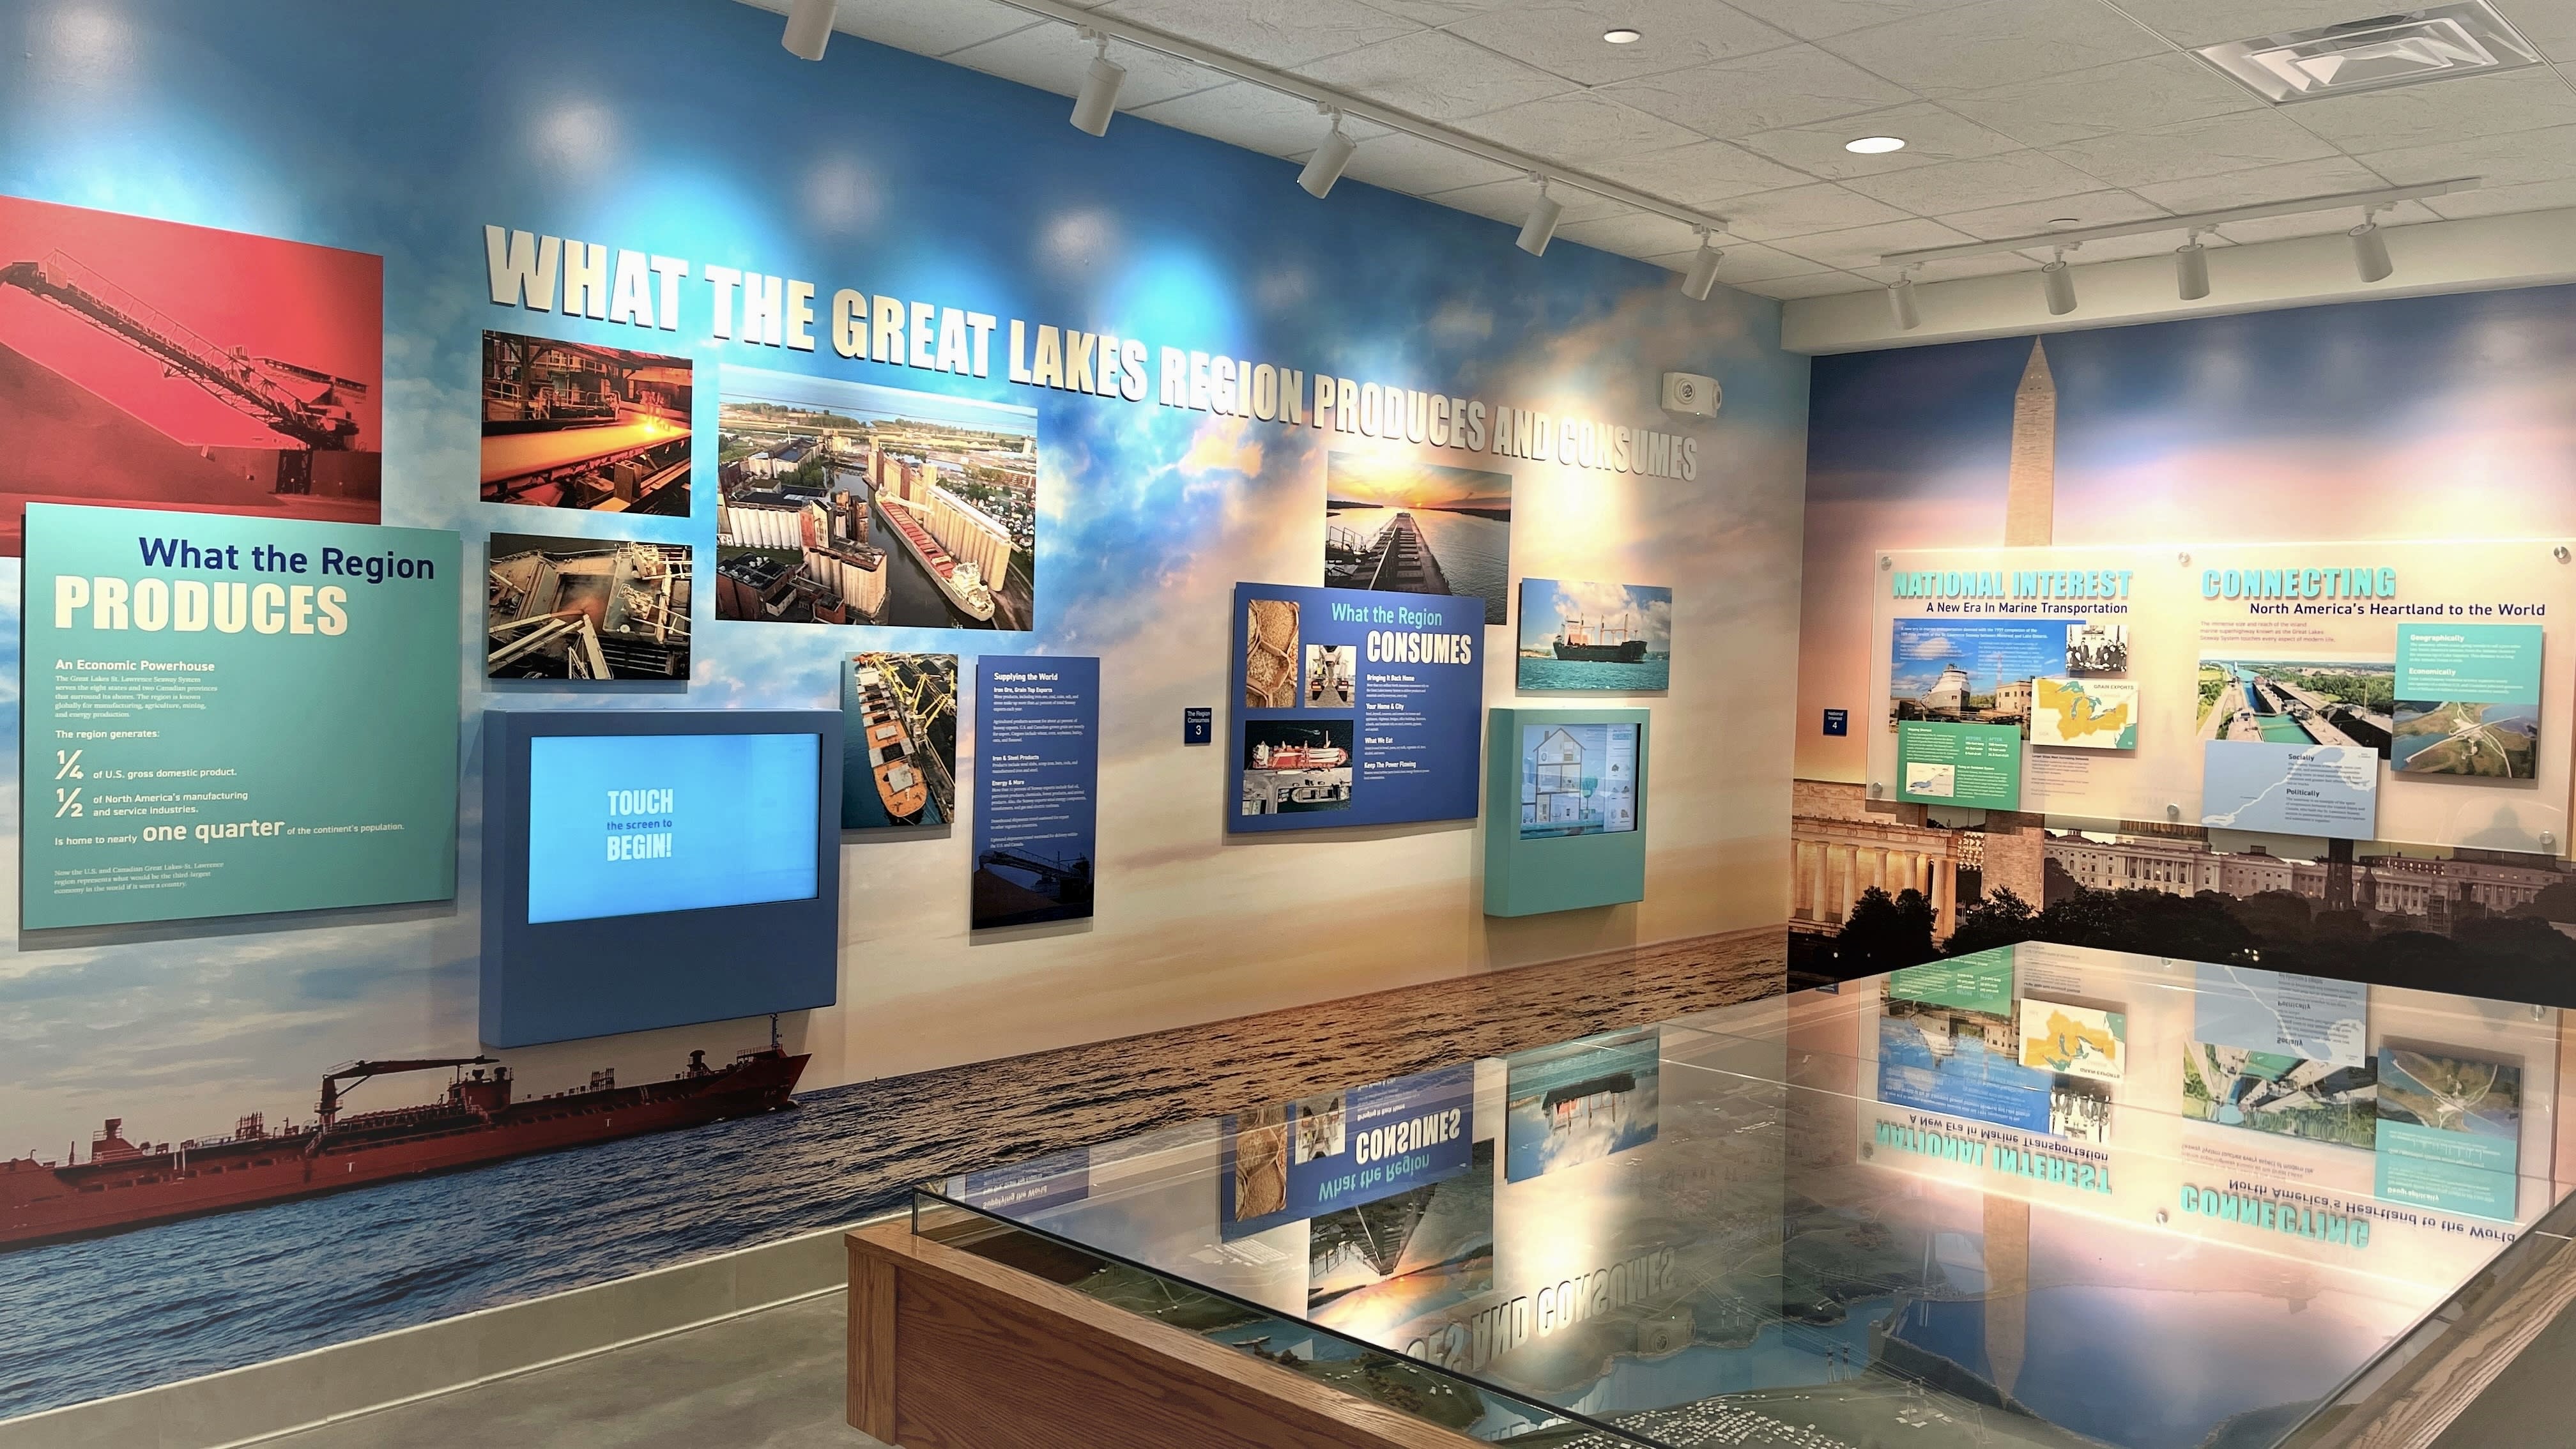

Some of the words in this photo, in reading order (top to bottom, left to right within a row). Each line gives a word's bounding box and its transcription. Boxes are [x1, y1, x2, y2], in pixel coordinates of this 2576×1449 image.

[485, 224, 688, 331] WHAT
[705, 264, 815, 352] THE
[832, 288, 997, 378] GREAT
[1009, 319, 1147, 402] LAKES
[1160, 346, 1302, 425] REGION
[1313, 374, 1486, 452] PRODUCES
[1491, 405, 1551, 462] AND
[1558, 417, 1697, 482] CONSUMES
[139, 537, 238, 571] What
[252, 544, 307, 573] the
[322, 548, 433, 584] Region
[1892, 571, 2005, 599] NATIONAL
[2012, 569, 2133, 600] INTEREST
[2201, 567, 2396, 599] CONNECTING
[55, 575, 348, 637] PRODUCES
[1926, 602, 1933, 611] A
[1937, 602, 1959, 611] New
[1963, 602, 1981, 612] Era
[1985, 602, 1995, 612] In
[1998, 602, 2037, 612] Marine
[2041, 602, 2127, 615] Transportation
[2250, 603, 2288, 613] North
[2294, 603, 2365, 614] America's
[2370, 604, 2443, 614] Heartland
[2449, 605, 2463, 615] to
[2469, 604, 2492, 615] the
[2498, 604, 2545, 615] World
[1331, 602, 1368, 622] What
[1372, 604, 1395, 625] the
[1398, 606, 1443, 630] Region
[2410, 634, 2465, 643] Geographically
[1366, 630, 1472, 664] CONSUMES
[56, 659, 72, 669] An
[77, 659, 136, 670] Economic
[141, 661, 214, 671] Powerhouse
[994, 673, 1026, 682] Supplying
[2409, 668, 2456, 677] Economically
[76, 730, 107, 739] region
[110, 731, 160, 739] generates:
[1196, 724, 1201, 735] 3
[105, 770, 125, 778] U.S.
[127, 771, 154, 779] gross
[156, 769, 198, 777] domestic
[199, 768, 237, 776] product.
[134, 793, 180, 802] America's
[183, 792, 248, 801] manufacturing
[2286, 788, 2320, 797] Politically
[607, 788, 673, 816] TOUCH
[112, 807, 147, 815] service
[150, 805, 199, 814] industries.
[607, 821, 623, 830] the
[55, 837, 63, 845] Is
[66, 836, 92, 845] home
[107, 834, 137, 844] nearly
[142, 825, 187, 841] one
[195, 820, 285, 843] quarter
[313, 825, 358, 833] continent's
[360, 823, 404, 832] population.
[607, 832, 672, 861] BEGIN!
